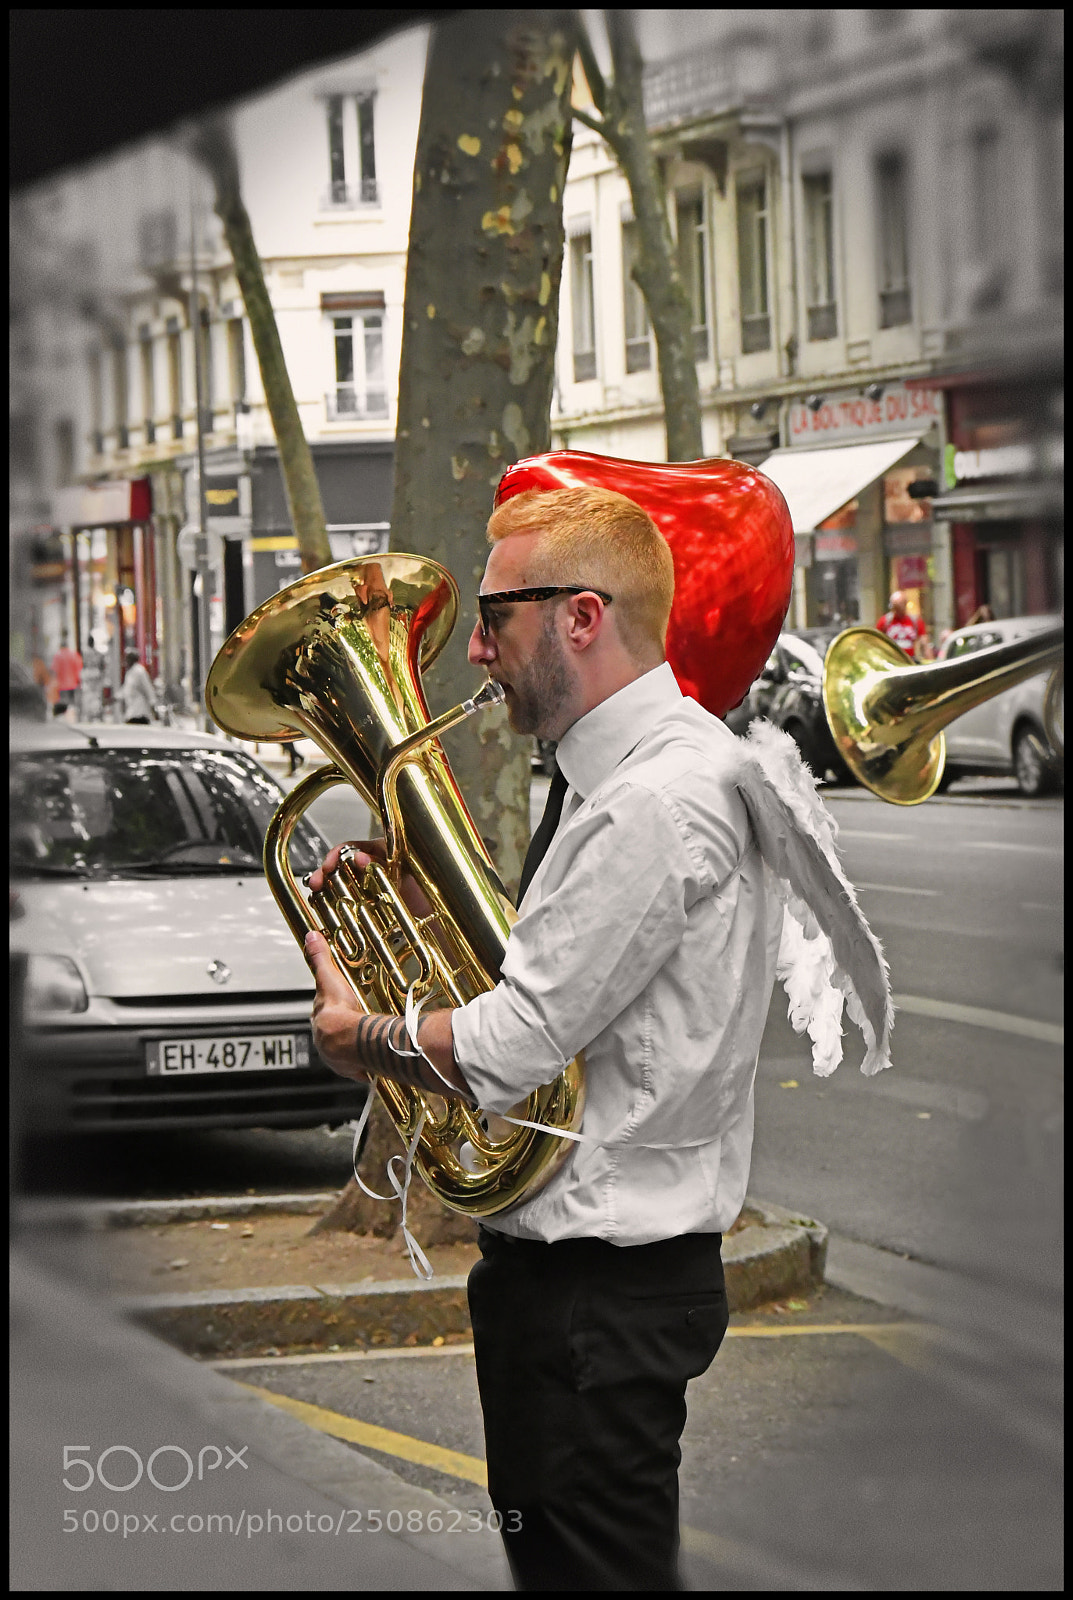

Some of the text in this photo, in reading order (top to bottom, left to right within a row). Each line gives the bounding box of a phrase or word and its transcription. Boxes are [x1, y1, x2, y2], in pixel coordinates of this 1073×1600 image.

[791, 408, 809, 434] LA
[886, 395, 908, 421] DU
[163, 1039, 293, 1070] EH-487-WH
